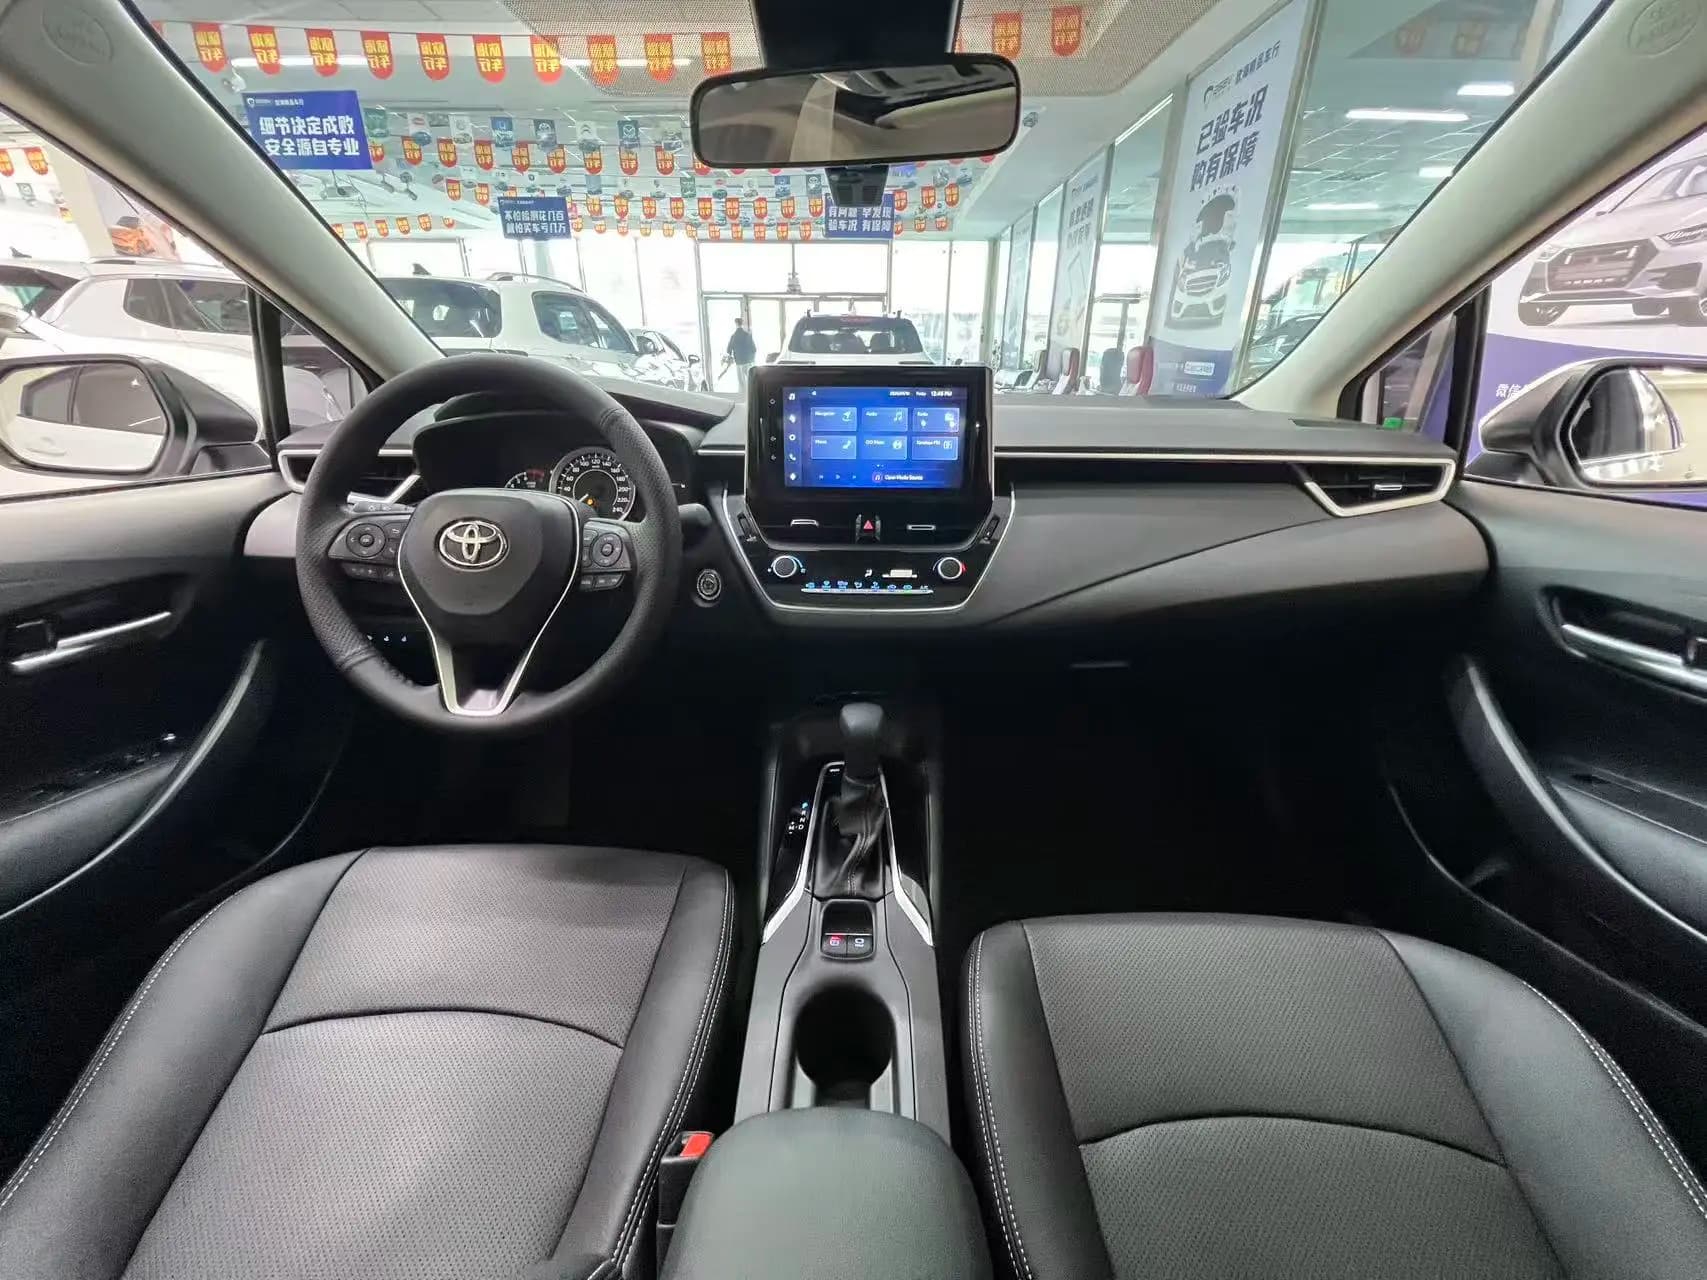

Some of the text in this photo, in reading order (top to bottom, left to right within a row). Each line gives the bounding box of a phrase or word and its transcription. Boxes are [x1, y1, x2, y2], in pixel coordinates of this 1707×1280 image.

[259, 115, 355, 135] 细节决定成败
[1197, 84, 1269, 155] 已验车况
[264, 138, 360, 156] 安全源自专业
[1190, 131, 1260, 192] 购有保障
